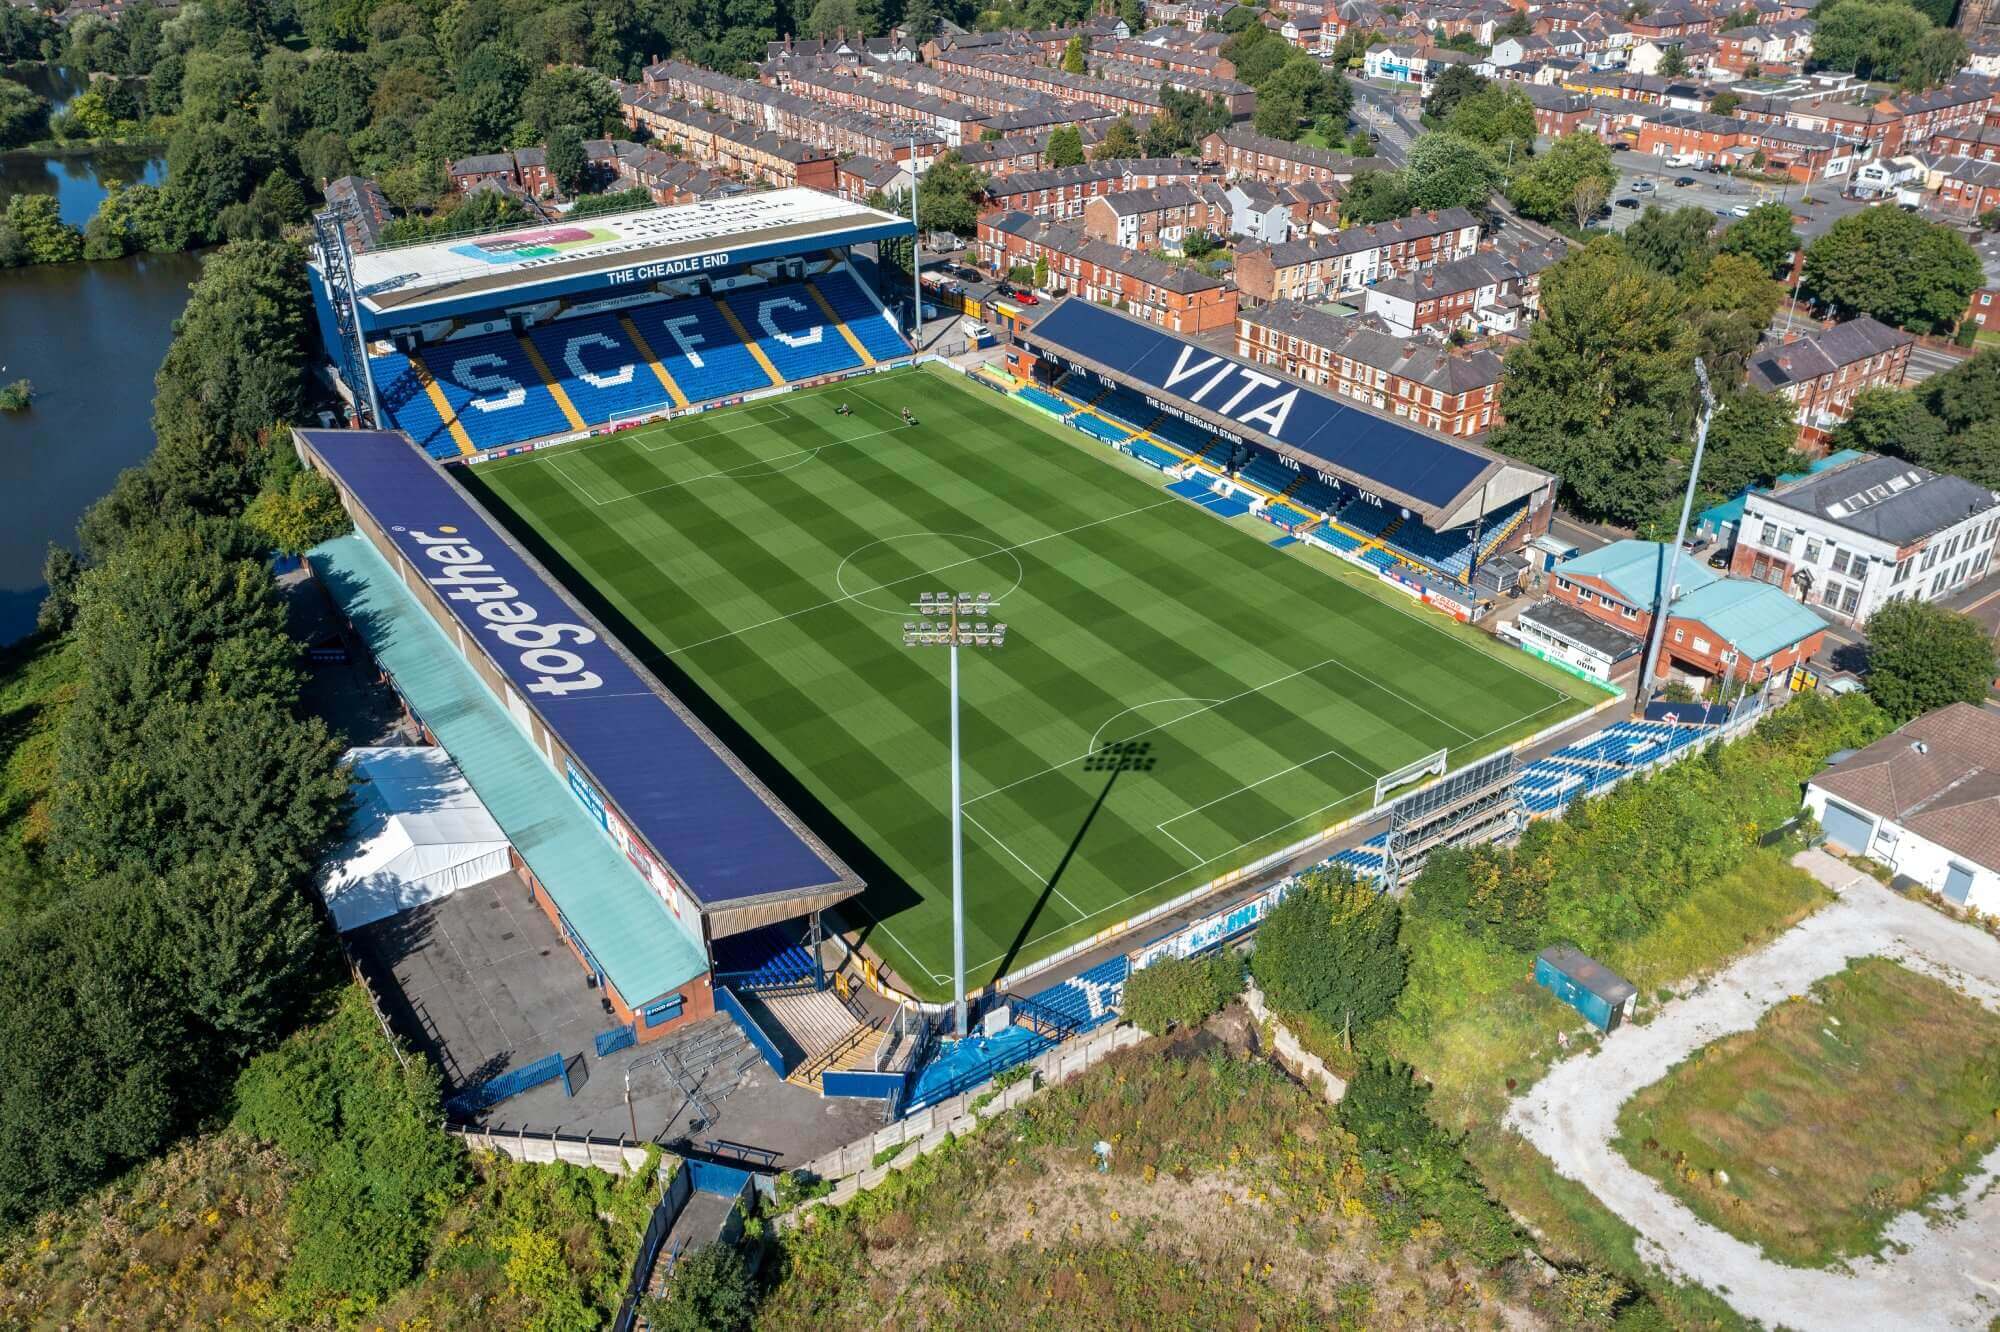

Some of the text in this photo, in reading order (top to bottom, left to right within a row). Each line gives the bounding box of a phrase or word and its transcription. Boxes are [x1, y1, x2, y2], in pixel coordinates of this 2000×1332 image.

[632, 199, 767, 224] Audio Visual
[651, 213, 759, 234] Electrical
[607, 253, 729, 285] THE CHEADLE END
[1041, 350, 1060, 366] VITA
[1069, 361, 1087, 378] VITA
[1098, 374, 1117, 391] VITA
[1162, 344, 1301, 438] VITA
[1065, 418, 1076, 429] VITA
[1145, 395, 1243, 446] THE DANNY BERGARA STAND
[1100, 435, 1111, 446] VITA
[1121, 445, 1133, 457] VITA
[1278, 453, 1301, 473] VITA
[1317, 470, 1341, 490] VITA
[1358, 488, 1383, 509] VITA
[1551, 648, 1565, 659] VITA
[1576, 660, 1596, 673] ODIN
